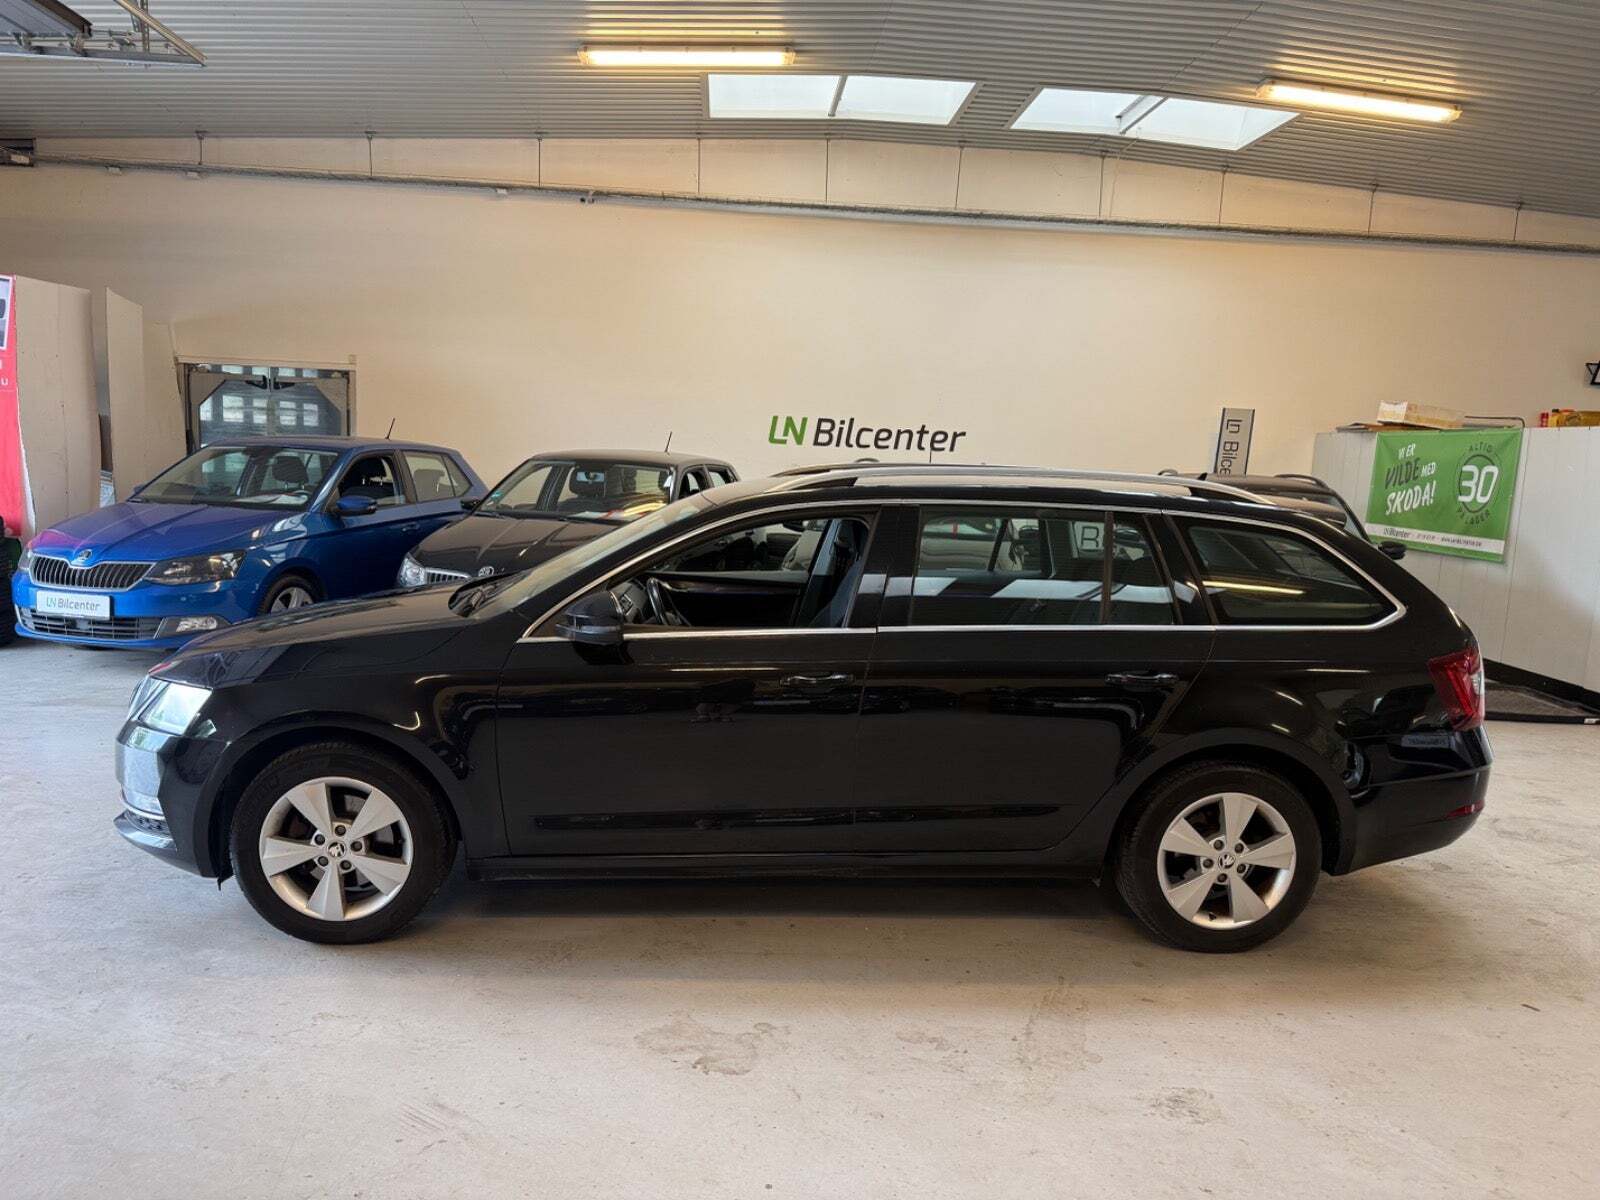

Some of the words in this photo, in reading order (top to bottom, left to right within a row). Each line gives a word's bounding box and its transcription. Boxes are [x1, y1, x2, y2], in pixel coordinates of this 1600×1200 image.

[768, 415, 808, 446] LN
[812, 416, 967, 452] Bilcenter
[1385, 456, 1421, 490] VILDE
[1420, 461, 1437, 478] MED
[1457, 464, 1500, 504] 30
[57, 597, 101, 611] Bilcenter
